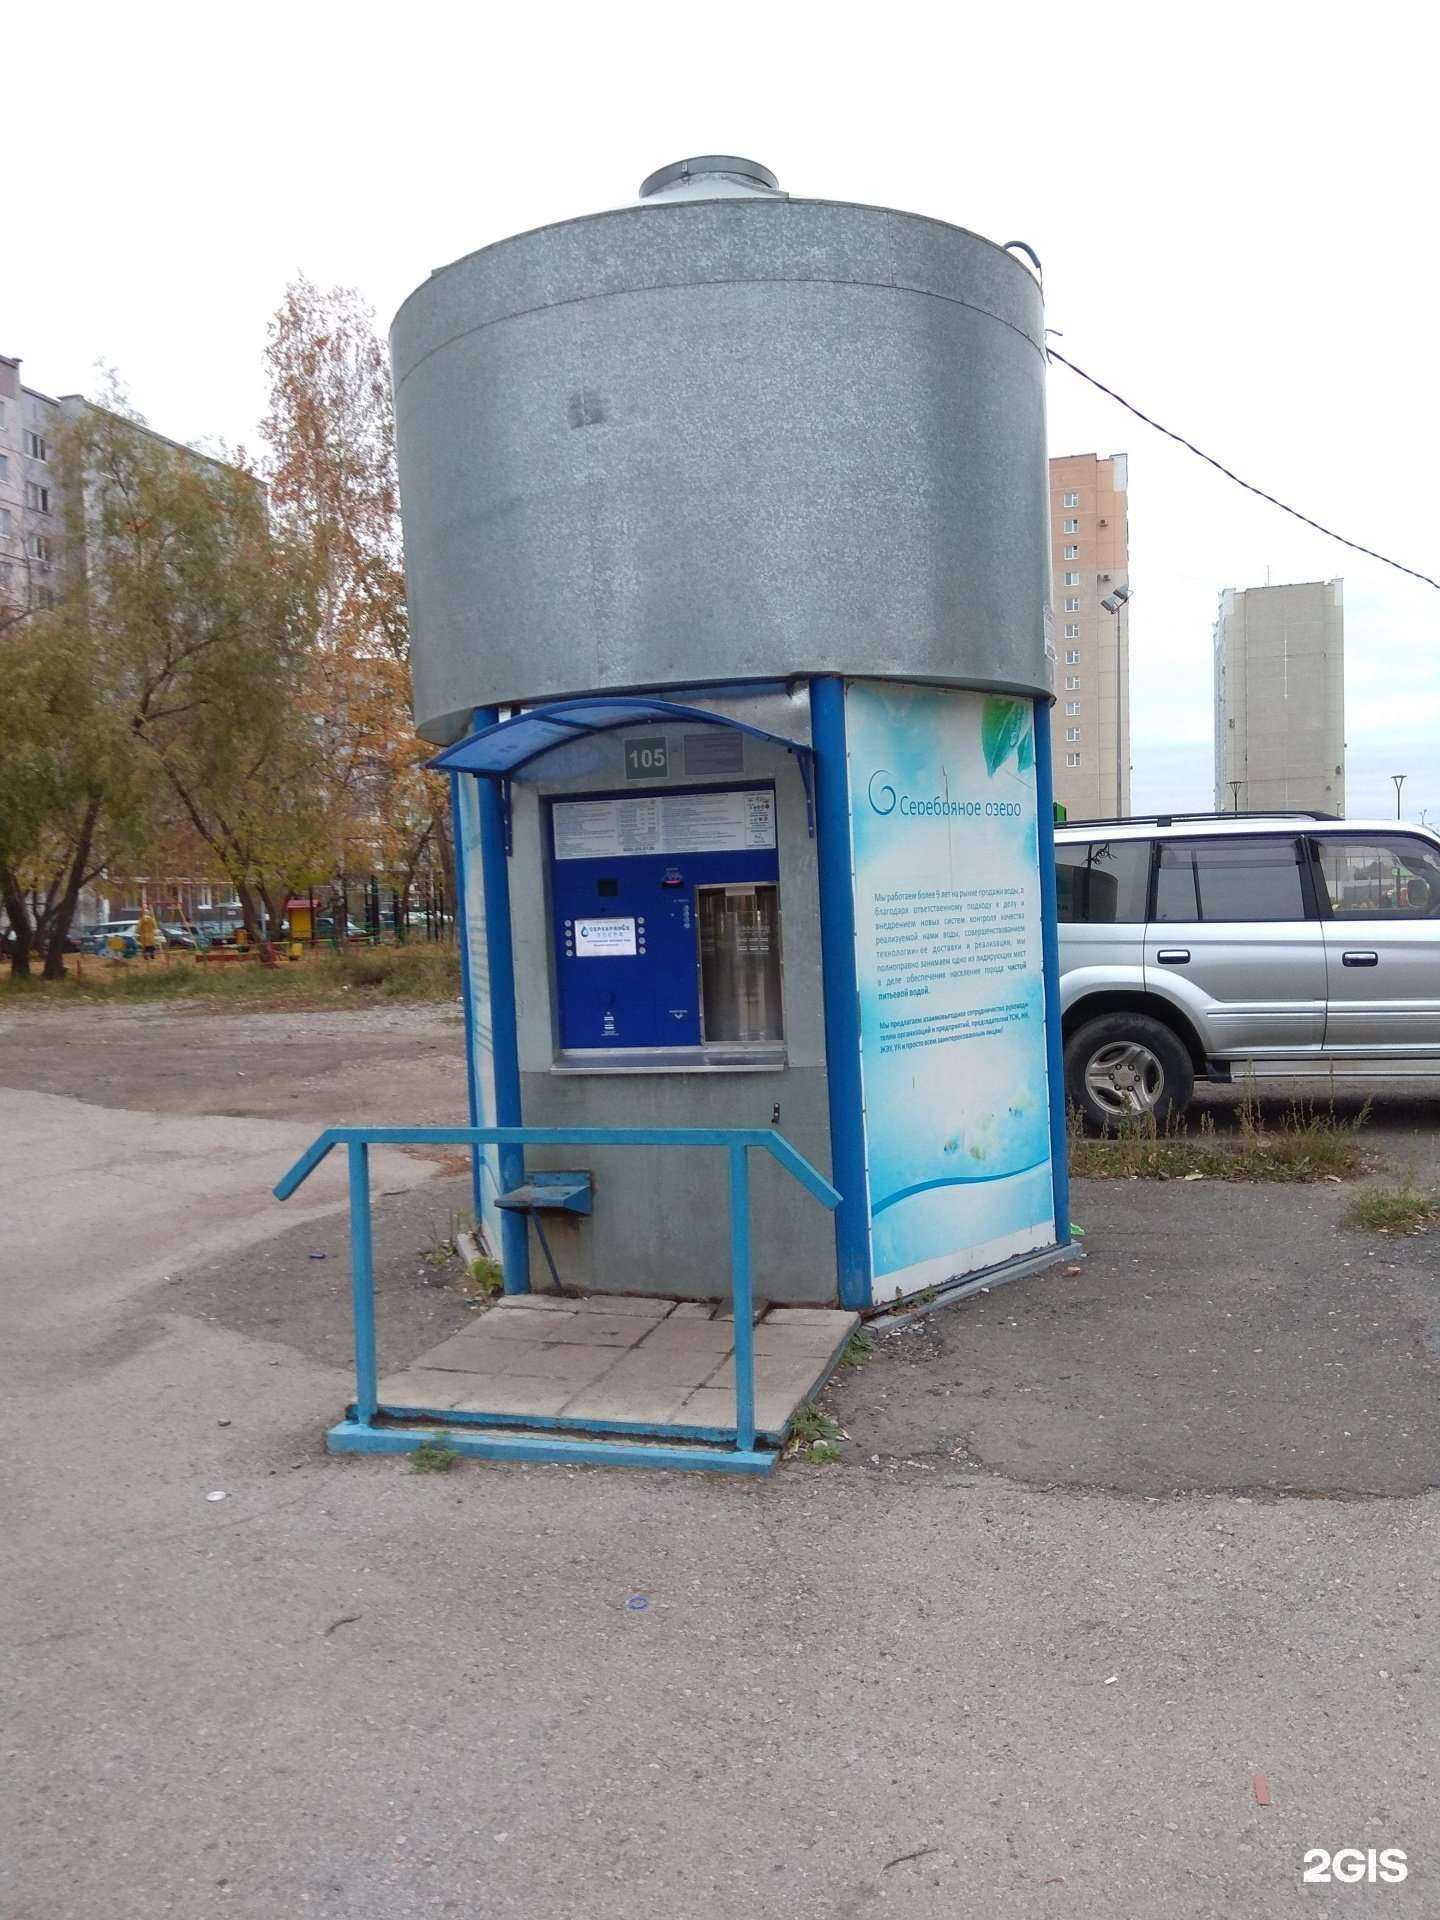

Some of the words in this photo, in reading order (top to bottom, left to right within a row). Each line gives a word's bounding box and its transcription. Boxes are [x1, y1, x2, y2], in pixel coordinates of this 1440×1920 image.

[628, 749, 666, 768] 105
[899, 796, 982, 817] Серебряное
[985, 801, 1022, 817] озеро
[874, 893, 886, 903] Мы
[886, 891, 916, 903] работаем
[917, 890, 936, 900] более
[942, 890, 952, 899] лет
[959, 889, 978, 899] рынке
[978, 887, 1004, 898] продажи
[913, 903, 962, 915] ответственному
[967, 902, 992, 912] подходу
[1003, 900, 1017, 910] делу
[875, 921, 917, 931] внедрением
[920, 919, 940, 928] новых
[944, 917, 965, 926] систем
[969, 914, 997, 925] контроля
[1000, 912, 1025, 922] качества
[875, 931, 918, 946] реализуемой
[923, 932, 939, 941] нами
[932, 944, 962, 956] доставки
[920, 956, 951, 969] занимаем
[1013, 949, 1026, 959] мест
[886, 976, 902, 987] деле
[906, 972, 946, 985] обеспечения
[950, 967, 981, 979] населения
[984, 964, 1004, 976] города
[1007, 960, 1027, 972] чистой
[878, 988, 909, 1001] питьевой
